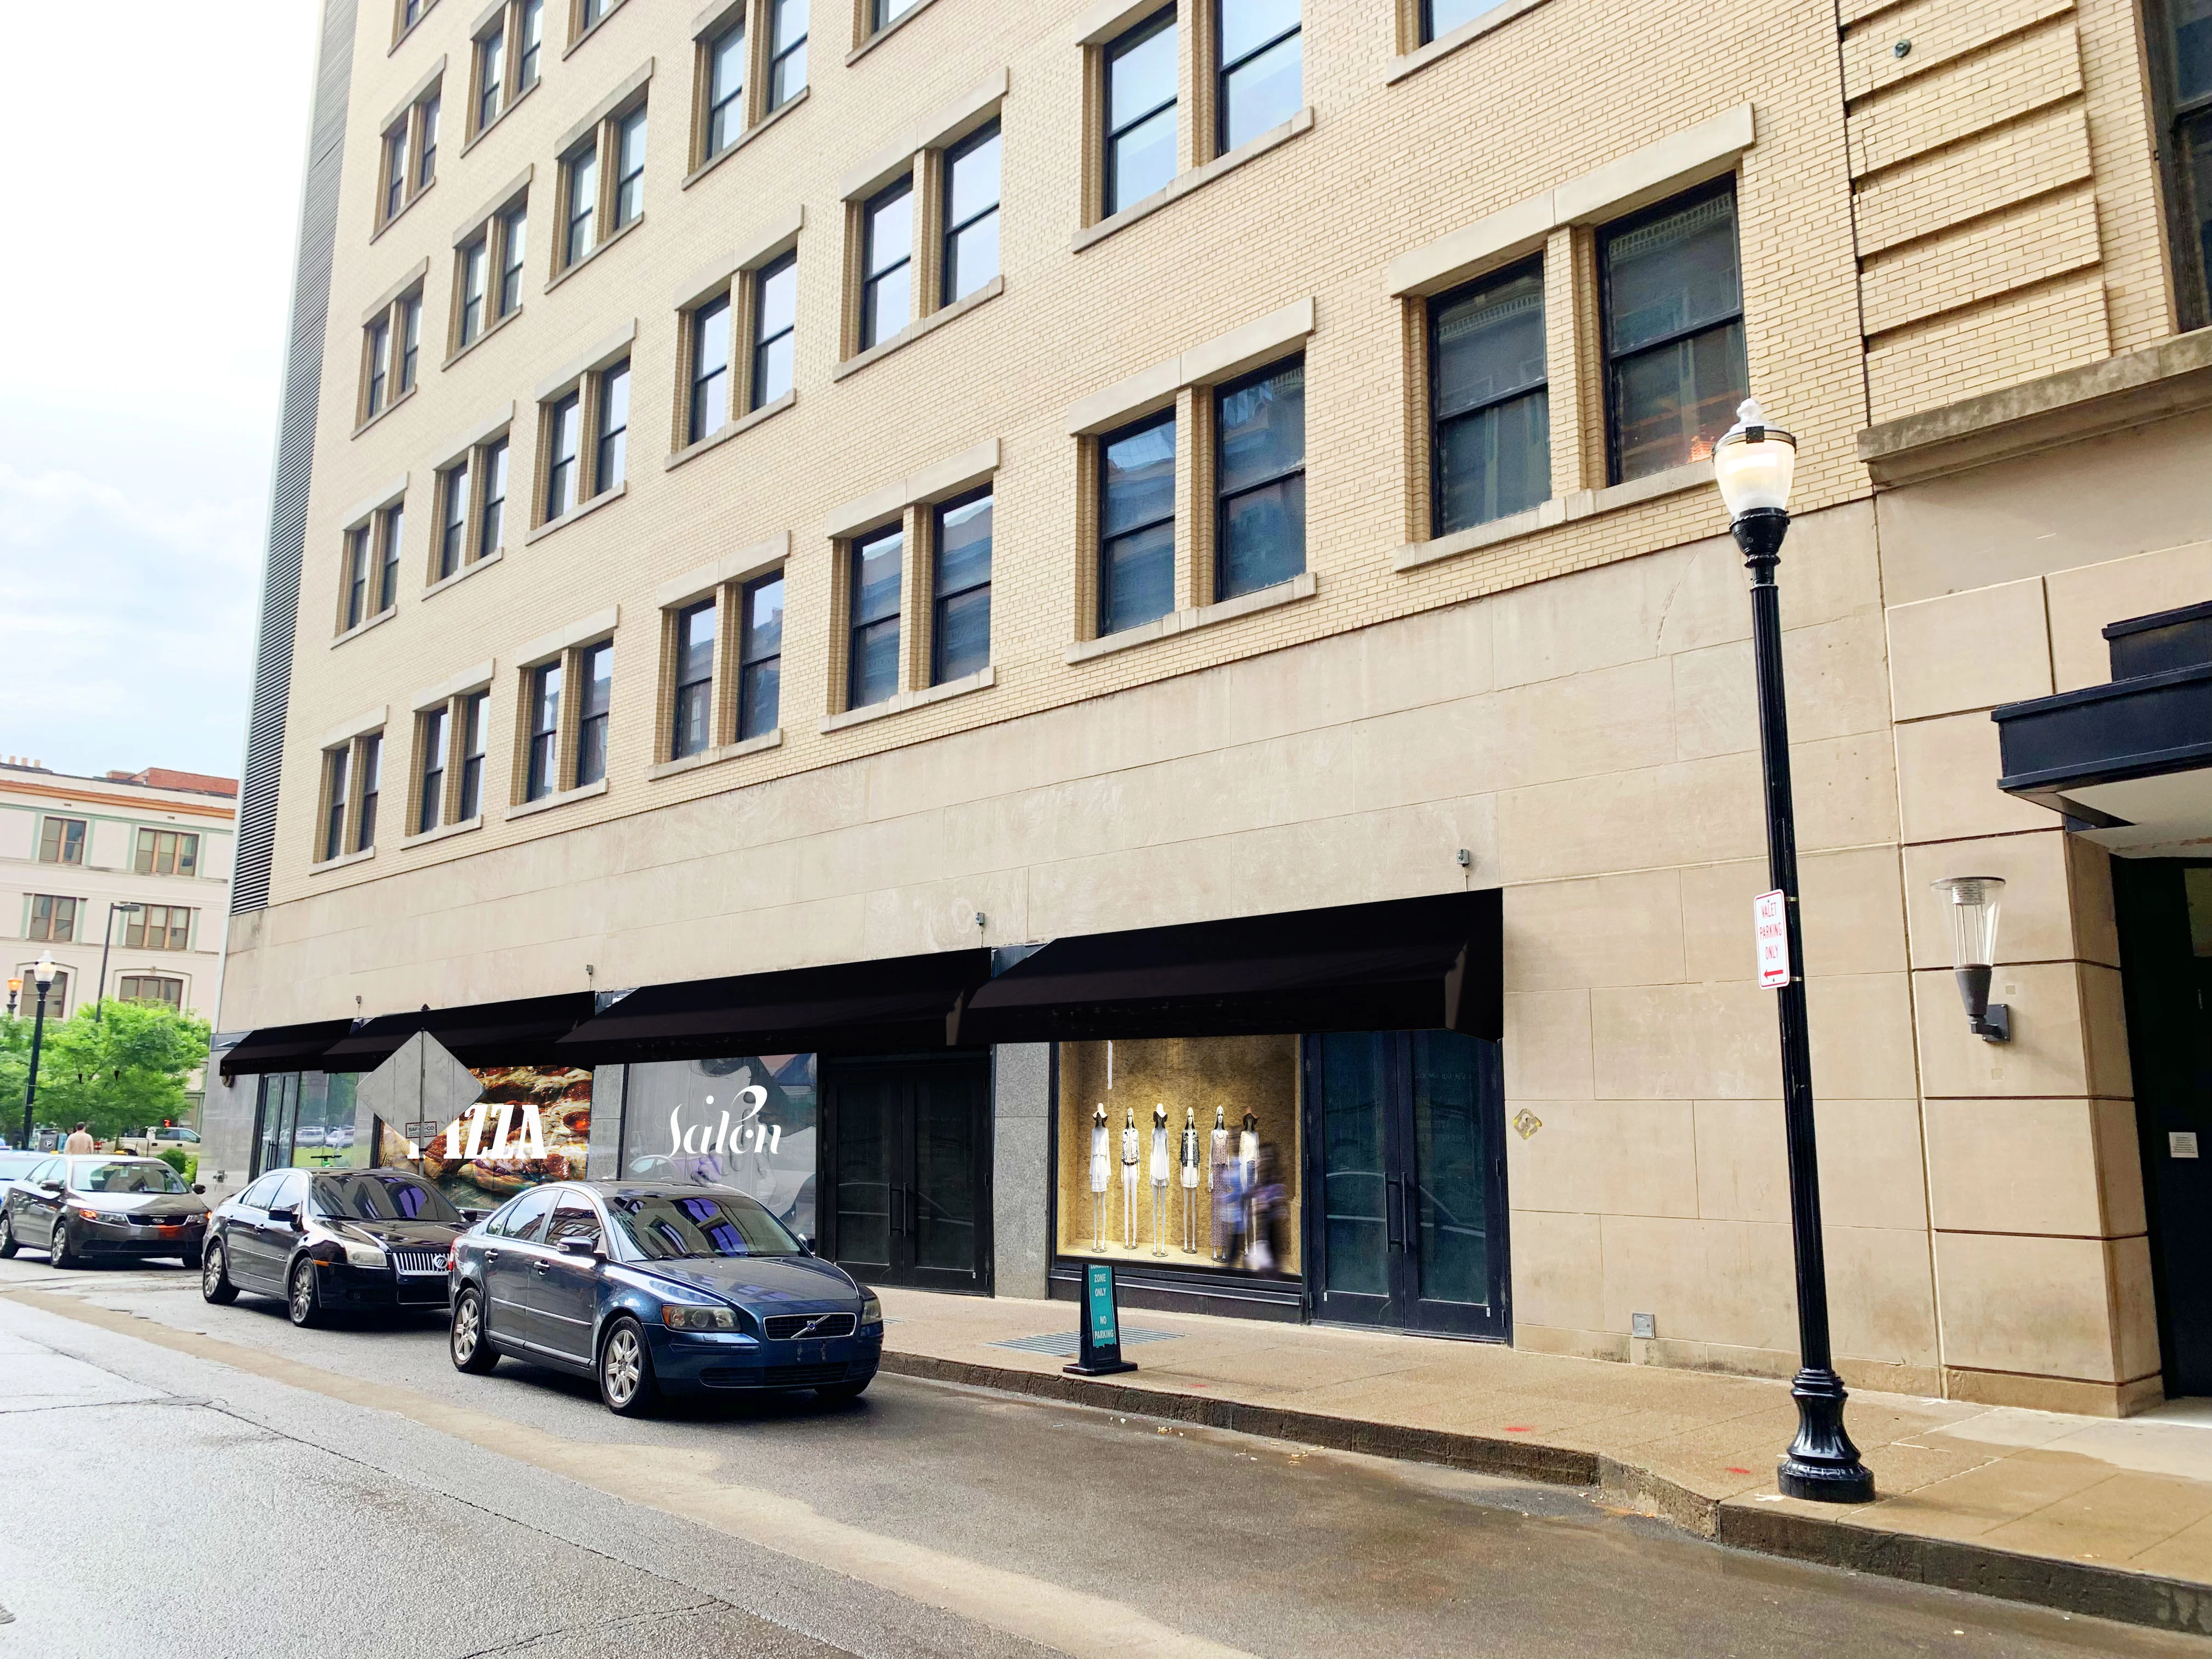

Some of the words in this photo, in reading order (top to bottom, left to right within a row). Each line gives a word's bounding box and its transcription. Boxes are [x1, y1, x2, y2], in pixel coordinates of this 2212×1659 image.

[1761, 902, 1777, 918] VALET
[1759, 922, 1782, 940] PARKING
[1765, 944, 1779, 960] ONLY
[667, 1085, 781, 1159] Salon
[407, 1104, 548, 1159] IZZA
[1094, 1273, 1107, 1283] ZONE
[1094, 1288, 1107, 1297] ONLY
[1099, 1316, 1107, 1325] NO
[1094, 1329, 1114, 1339] PARKING
